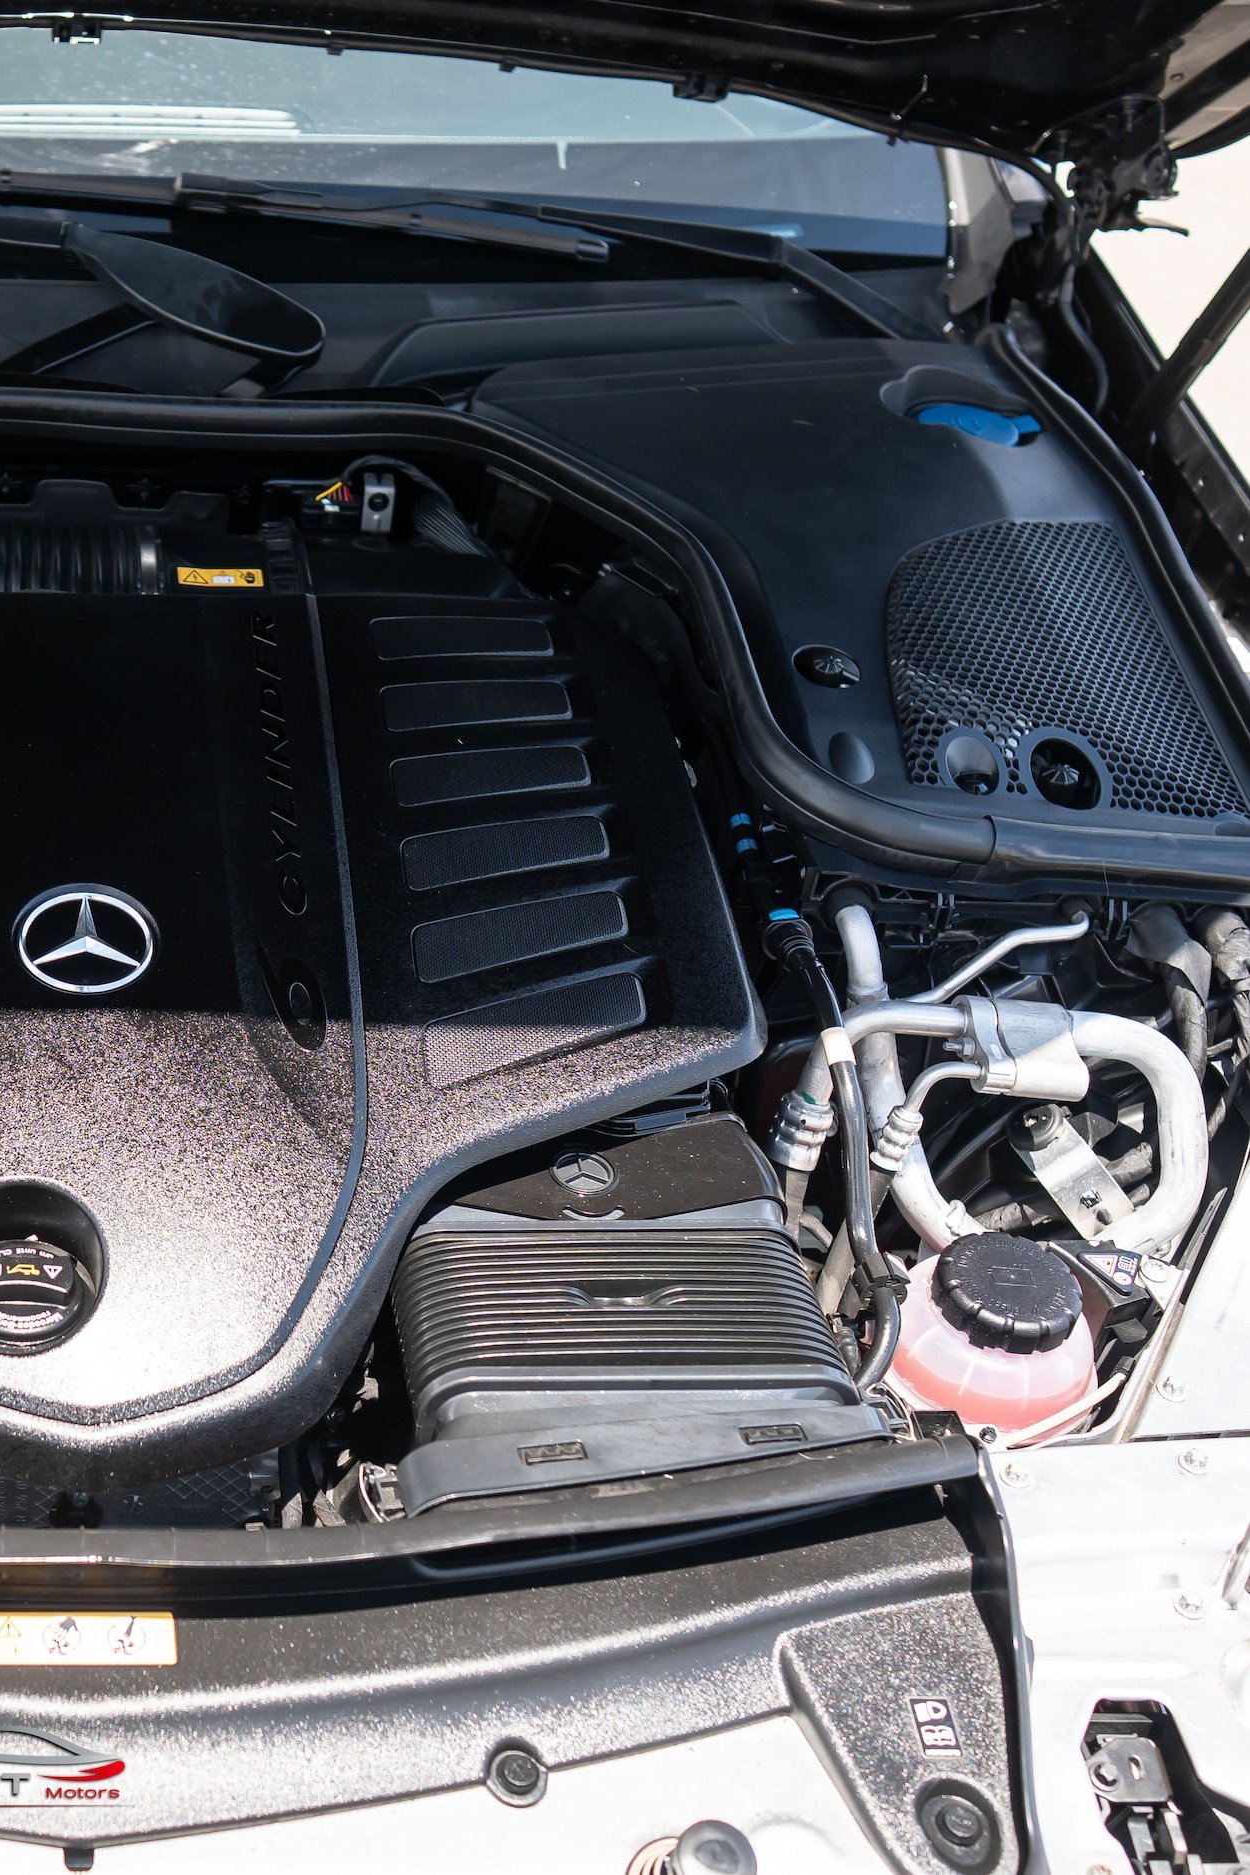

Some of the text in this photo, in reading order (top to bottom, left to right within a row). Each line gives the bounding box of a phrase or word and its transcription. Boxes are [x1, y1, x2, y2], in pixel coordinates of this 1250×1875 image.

[252, 611, 327, 1052] 6 CYLINDER
[16, 1247, 37, 1255] until
